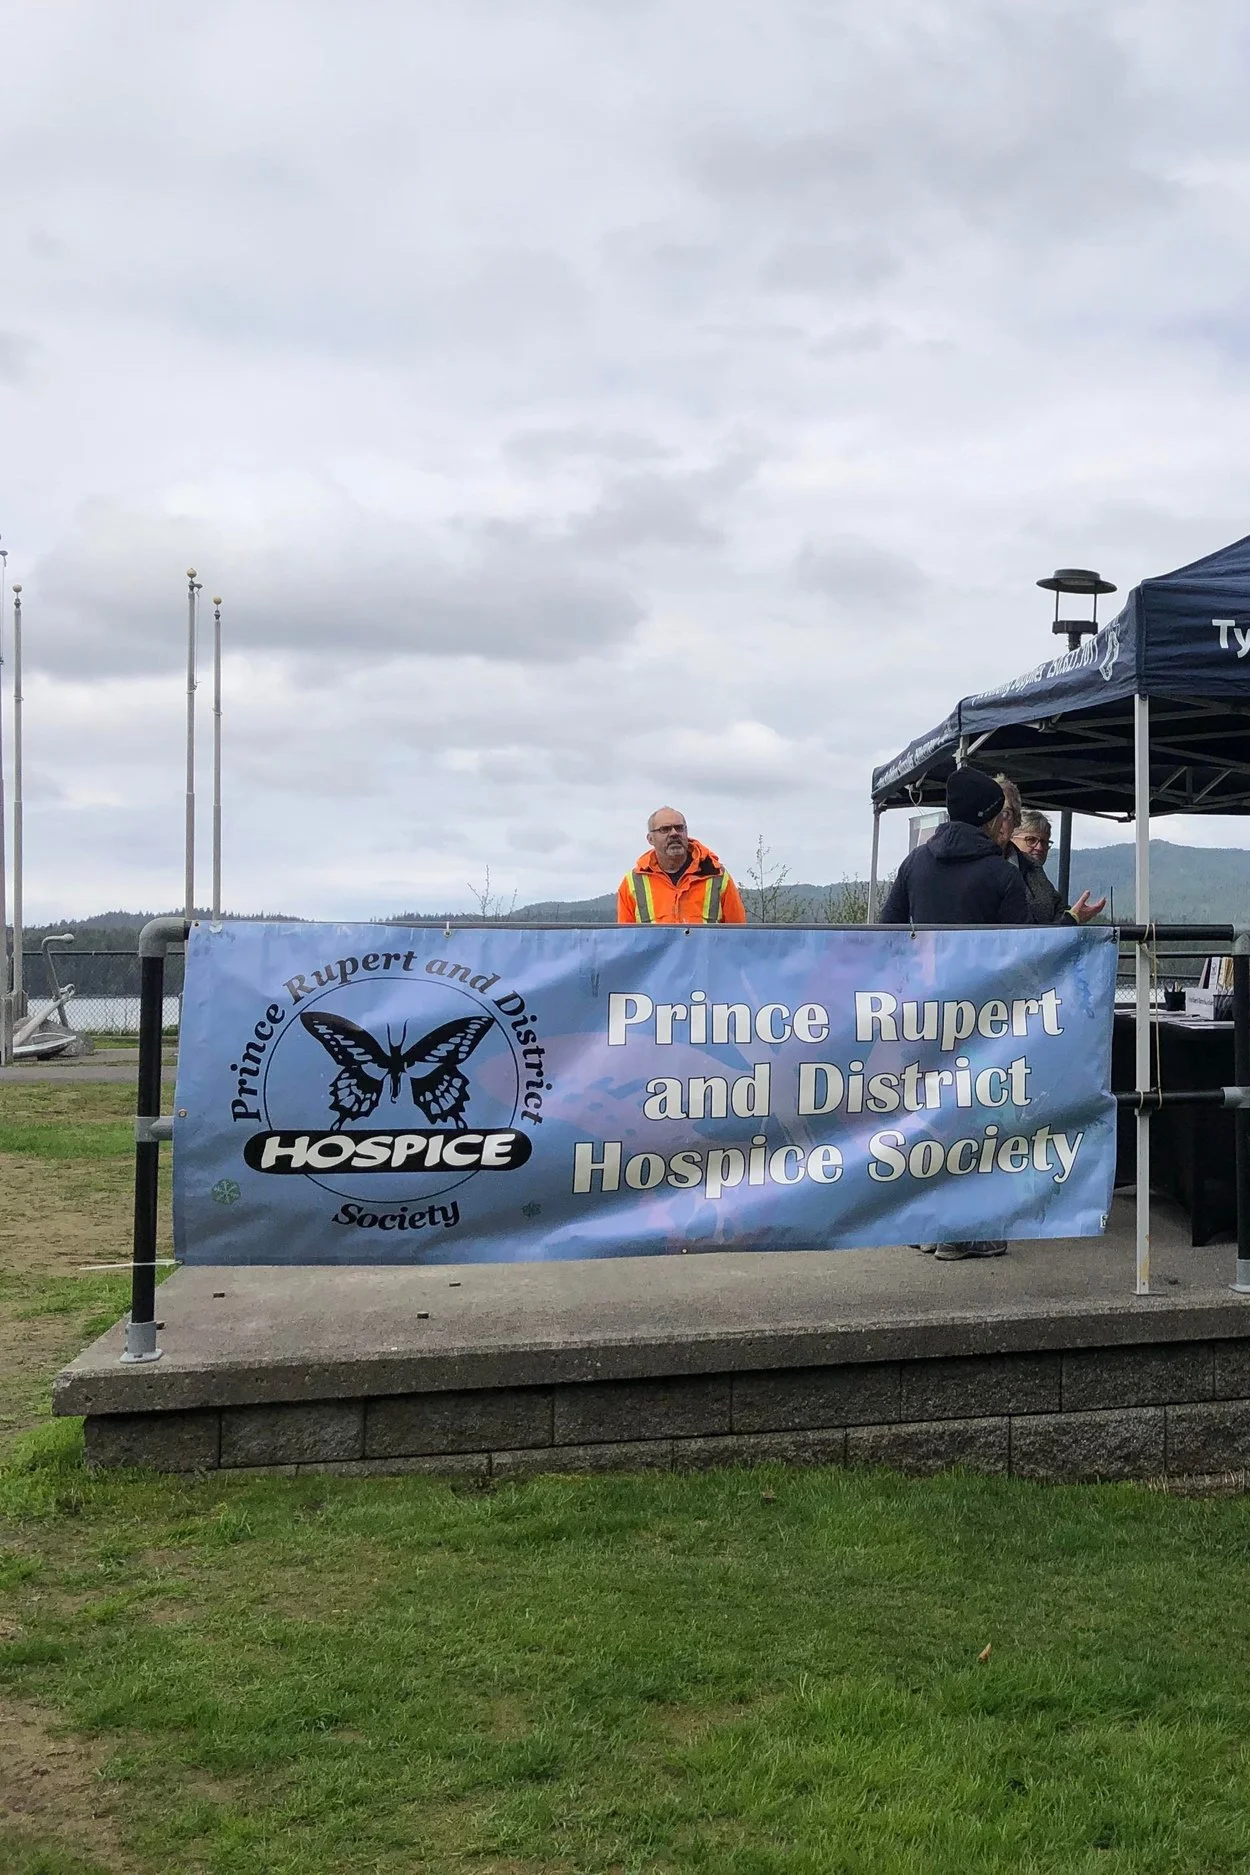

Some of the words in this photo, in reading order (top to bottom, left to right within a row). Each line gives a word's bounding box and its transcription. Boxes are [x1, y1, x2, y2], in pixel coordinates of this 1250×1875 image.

[230, 1002, 286, 1123] Prince
[282, 950, 418, 1006] Rupert
[425, 958, 501, 995] and
[492, 990, 553, 1126] District
[607, 990, 830, 1046] Prince
[854, 987, 1064, 1051] Rupert
[642, 1062, 771, 1120] and
[797, 1056, 1032, 1116] District
[261, 1133, 515, 1169] HOSPICE
[572, 1135, 844, 1199] Hospice
[867, 1124, 1084, 1184] Society
[331, 1200, 460, 1231] Society
